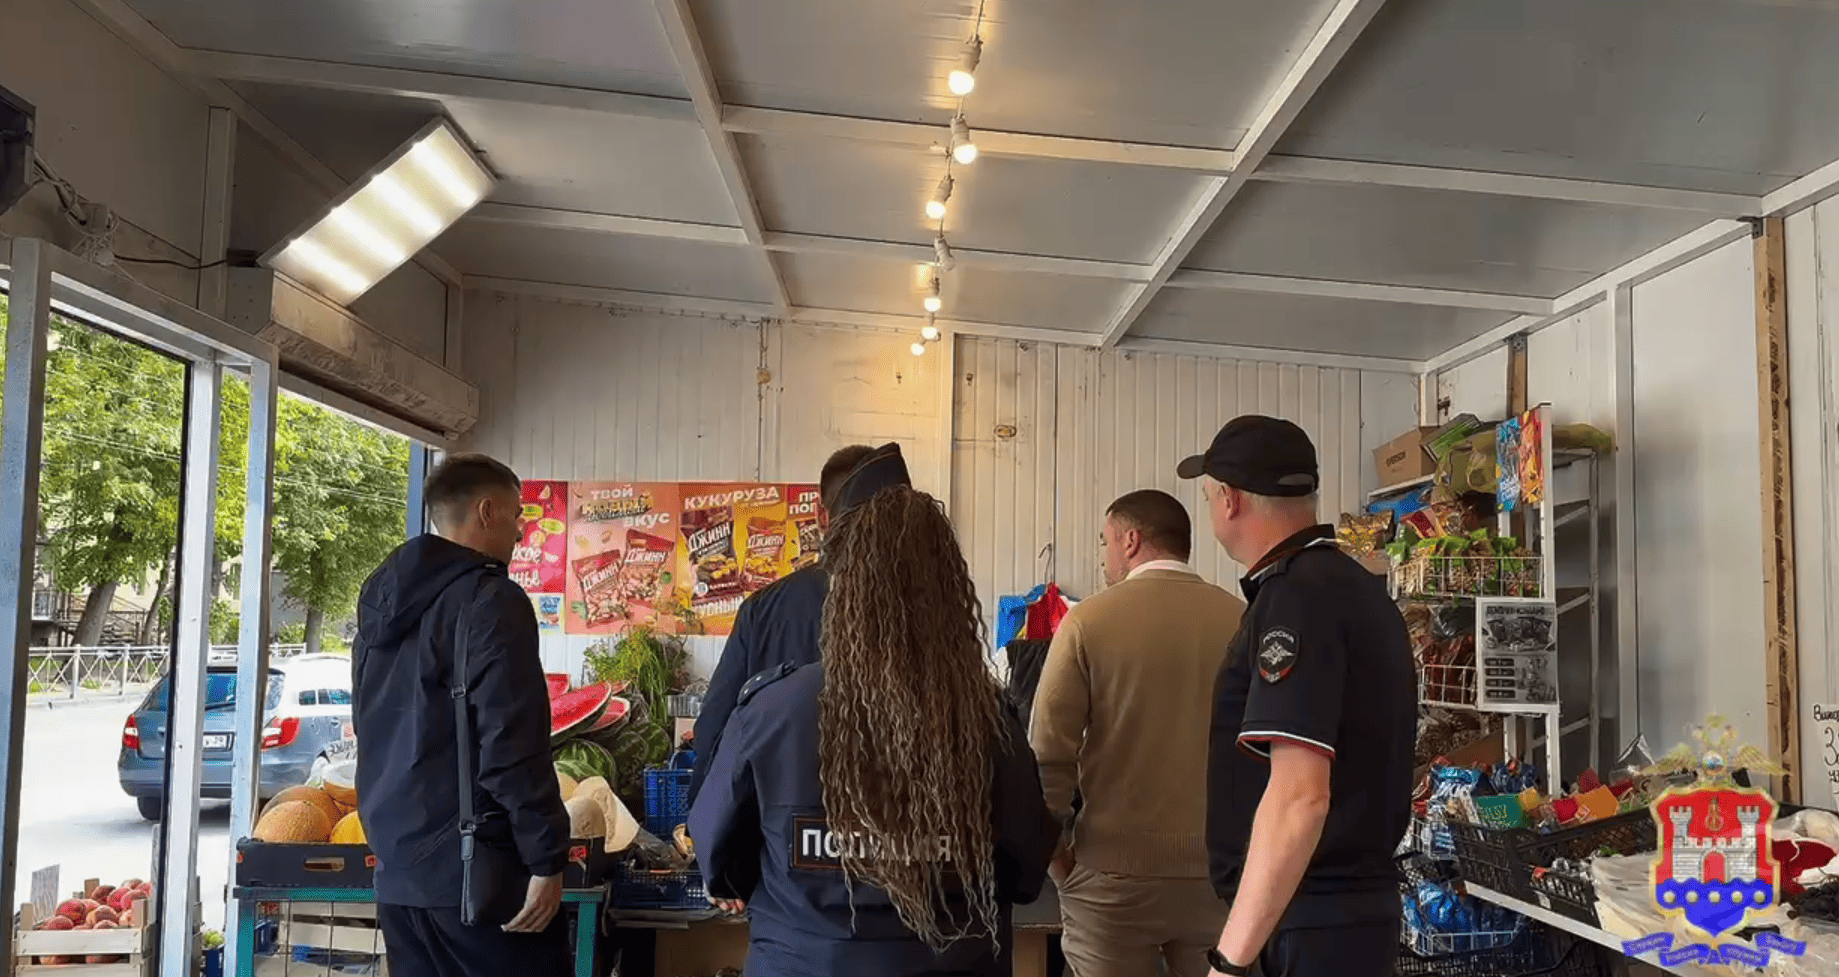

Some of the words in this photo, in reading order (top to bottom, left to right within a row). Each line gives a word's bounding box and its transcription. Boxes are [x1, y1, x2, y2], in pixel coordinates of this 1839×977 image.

[684, 486, 780, 510] КУКУРУЗА
[799, 492, 819, 502] ПР
[802, 828, 951, 864] ПОЛИЯ
